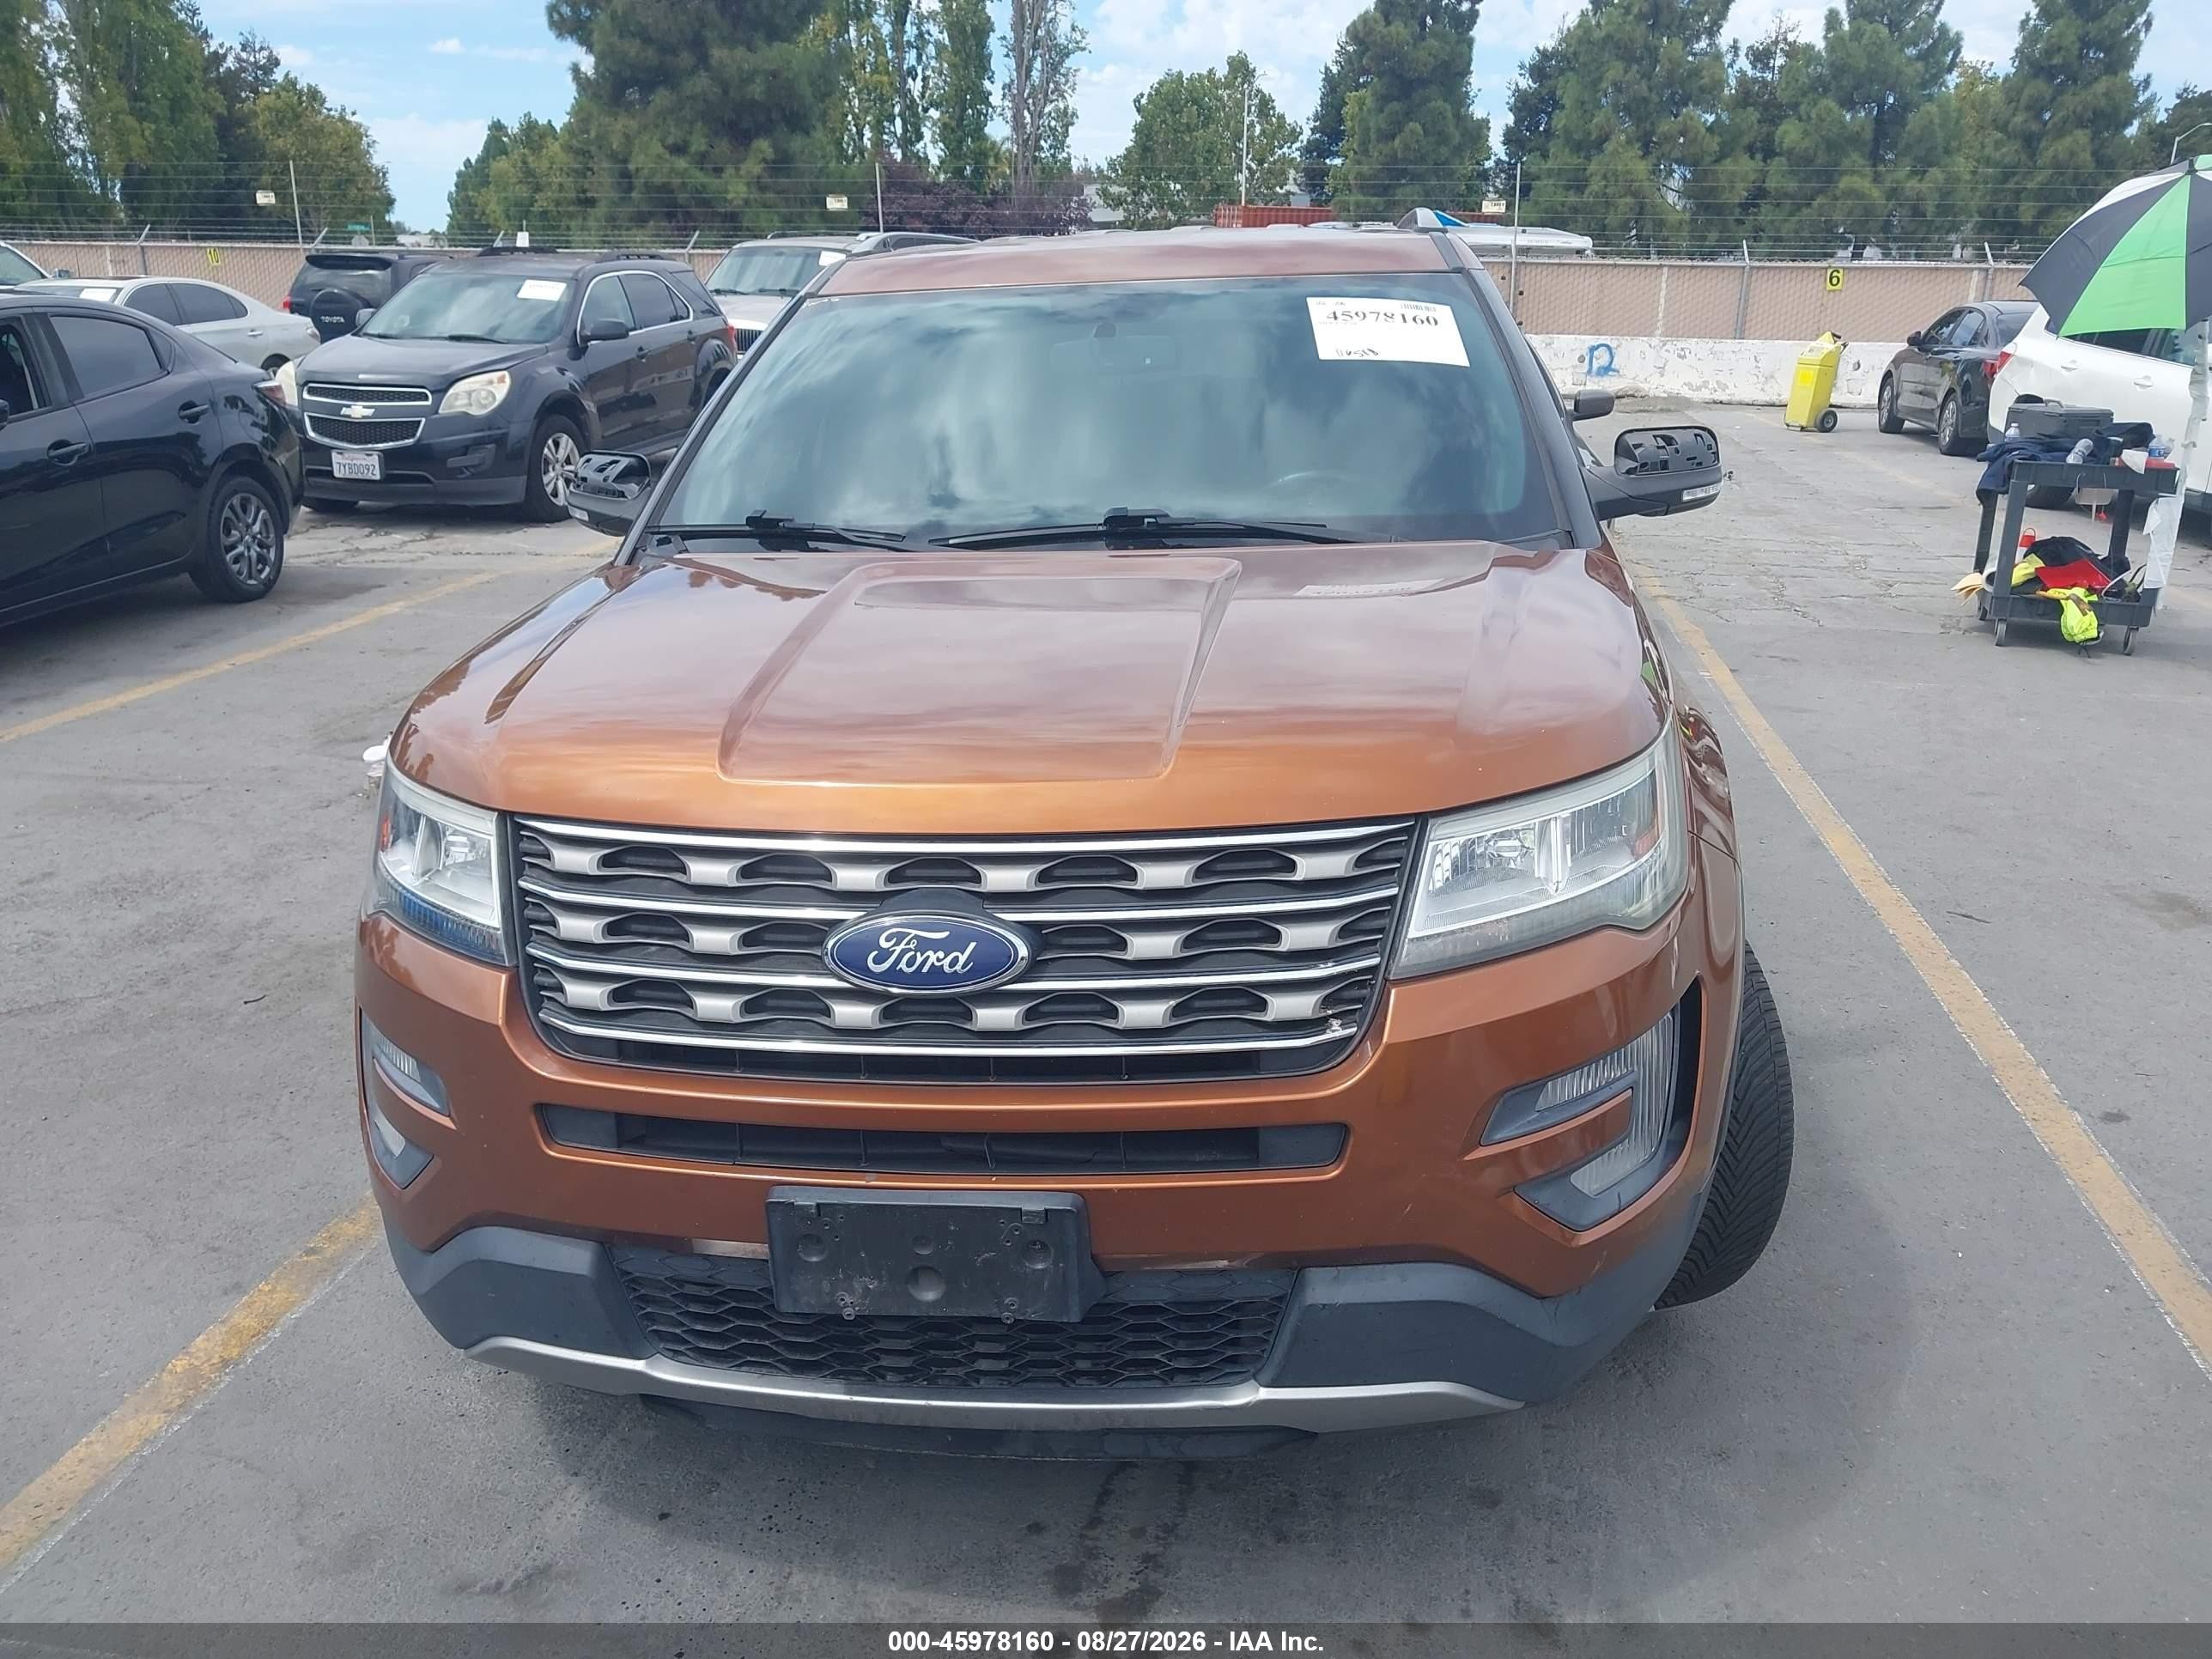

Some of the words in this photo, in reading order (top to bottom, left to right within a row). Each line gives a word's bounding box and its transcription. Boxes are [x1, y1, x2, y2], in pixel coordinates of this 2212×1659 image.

[209, 249, 219, 263] 10
[1829, 269, 1840, 287] 6
[1327, 310, 1438, 326] 45978160
[336, 461, 377, 476] 7YBD092
[866, 927, 977, 974] Ford
